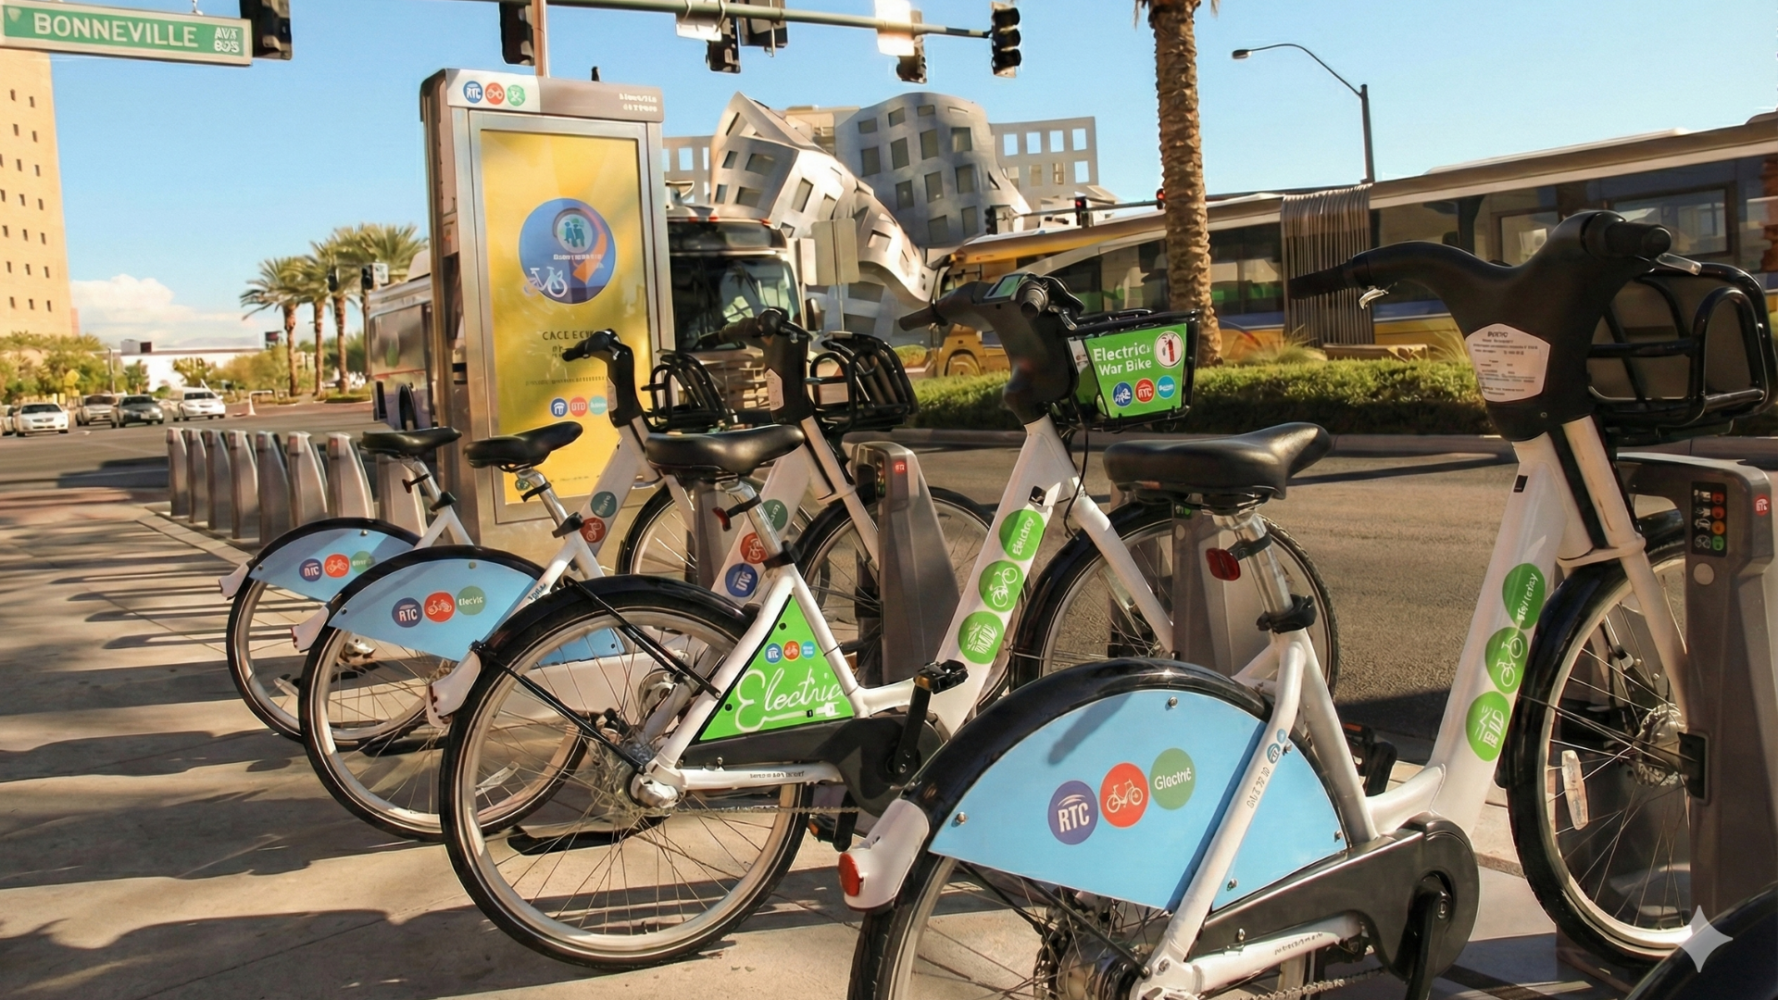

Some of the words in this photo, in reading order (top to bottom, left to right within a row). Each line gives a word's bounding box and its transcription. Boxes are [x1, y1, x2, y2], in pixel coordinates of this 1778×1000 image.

[33, 12, 199, 47] BONNEVILLE
[1126, 359, 1152, 373] Bike
[1057, 802, 1090, 833] RTC
